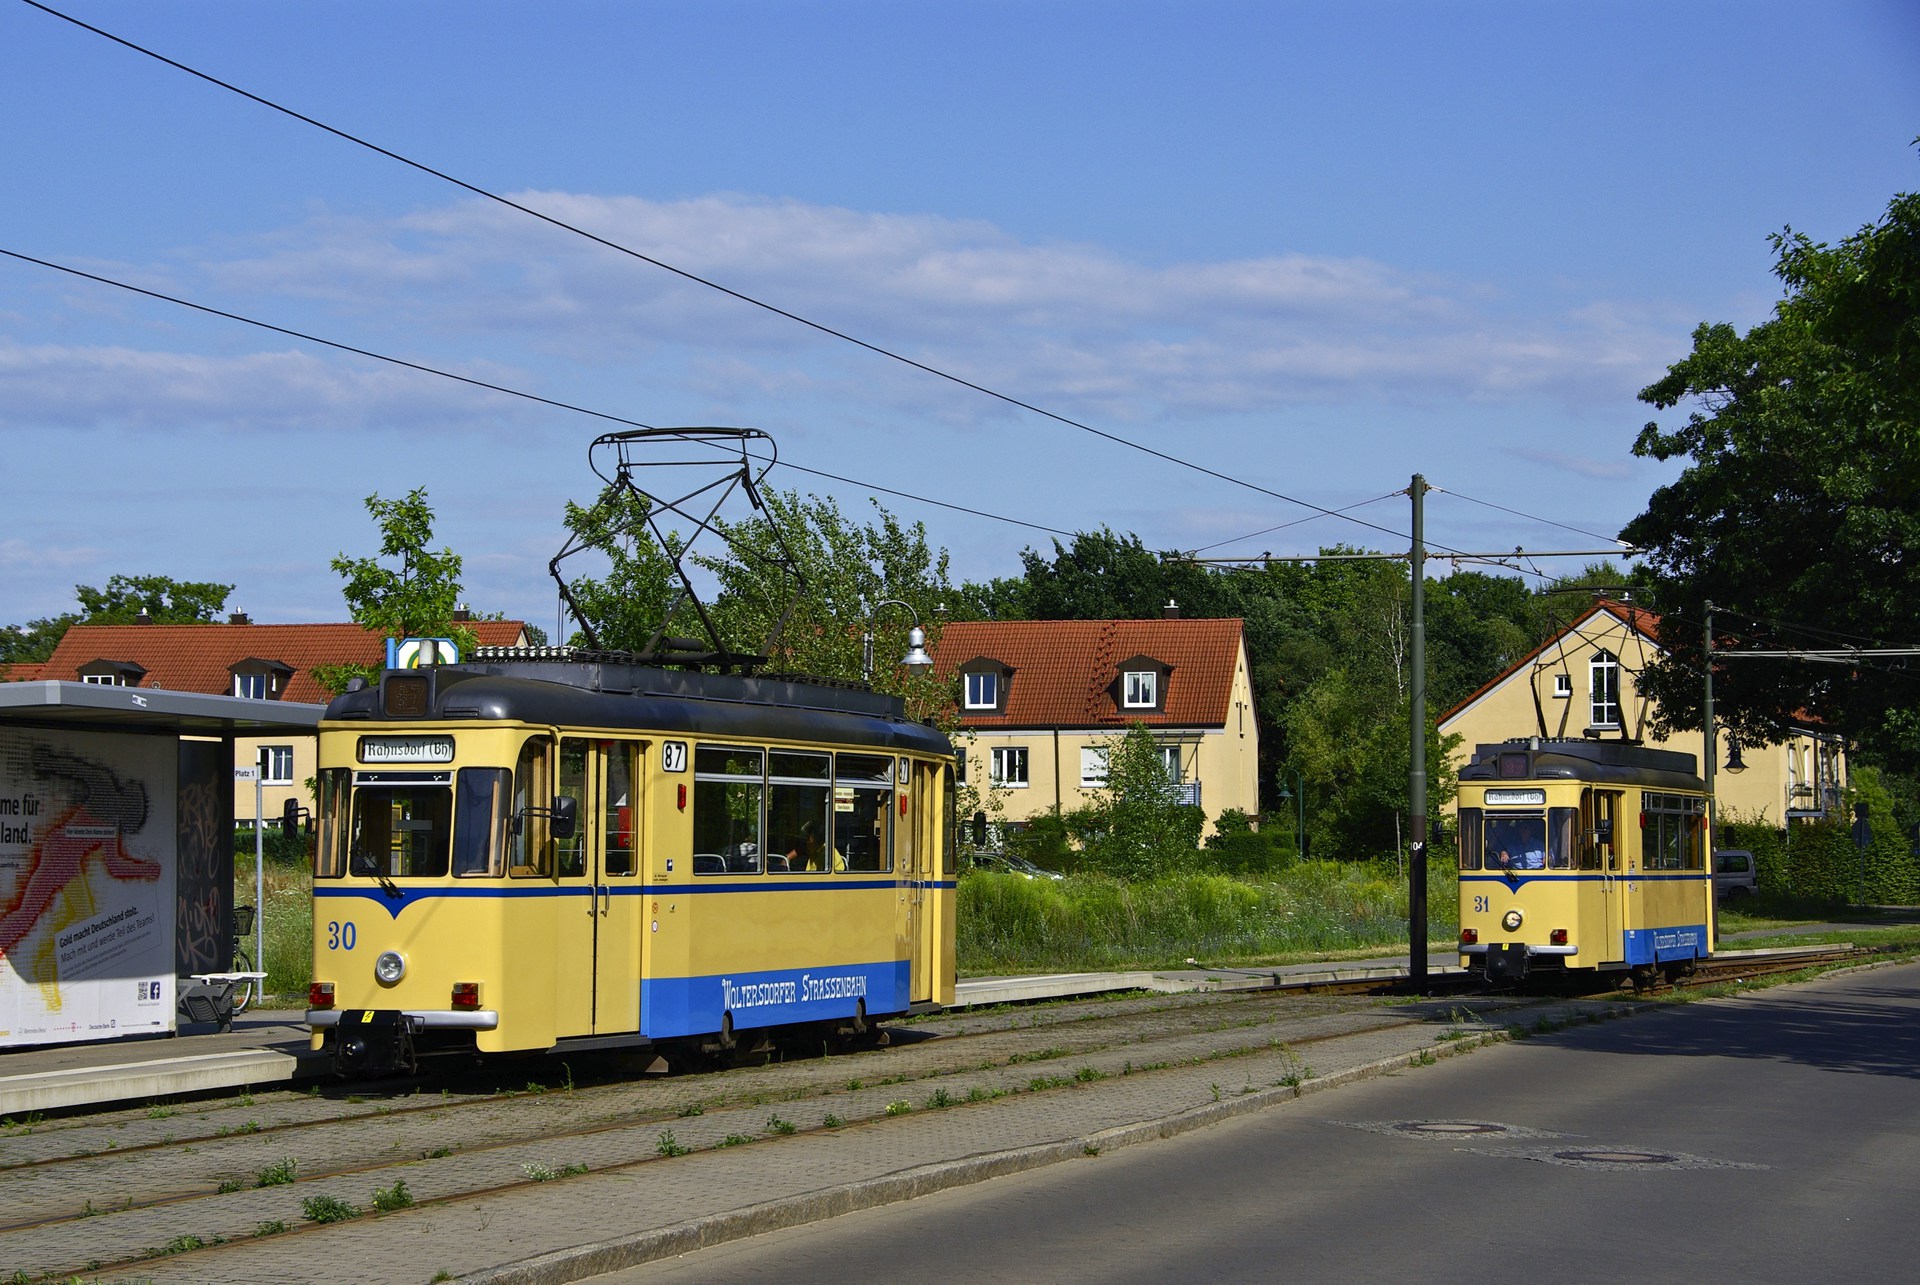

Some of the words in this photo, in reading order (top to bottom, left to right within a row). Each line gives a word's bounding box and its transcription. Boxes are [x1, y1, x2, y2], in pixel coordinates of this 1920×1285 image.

[367, 741, 426, 759] Rahnsdorf
[664, 744, 683, 768] 87
[22, 793, 40, 816] für
[0, 821, 32, 844] land.
[1410, 841, 1423, 850] 104
[1474, 895, 1489, 912] 31
[59, 933, 73, 948] Gold
[73, 926, 91, 942] macht
[91, 911, 124, 934] Deutschland
[124, 905, 139, 919] stolz.
[60, 948, 77, 962] Mach
[77, 944, 87, 956] mit
[87, 937, 99, 951] und
[99, 931, 116, 946] werde
[116, 925, 126, 938] Teil
[126, 922, 136, 934] des
[136, 912, 155, 929] Teams!
[328, 920, 357, 950] 30
